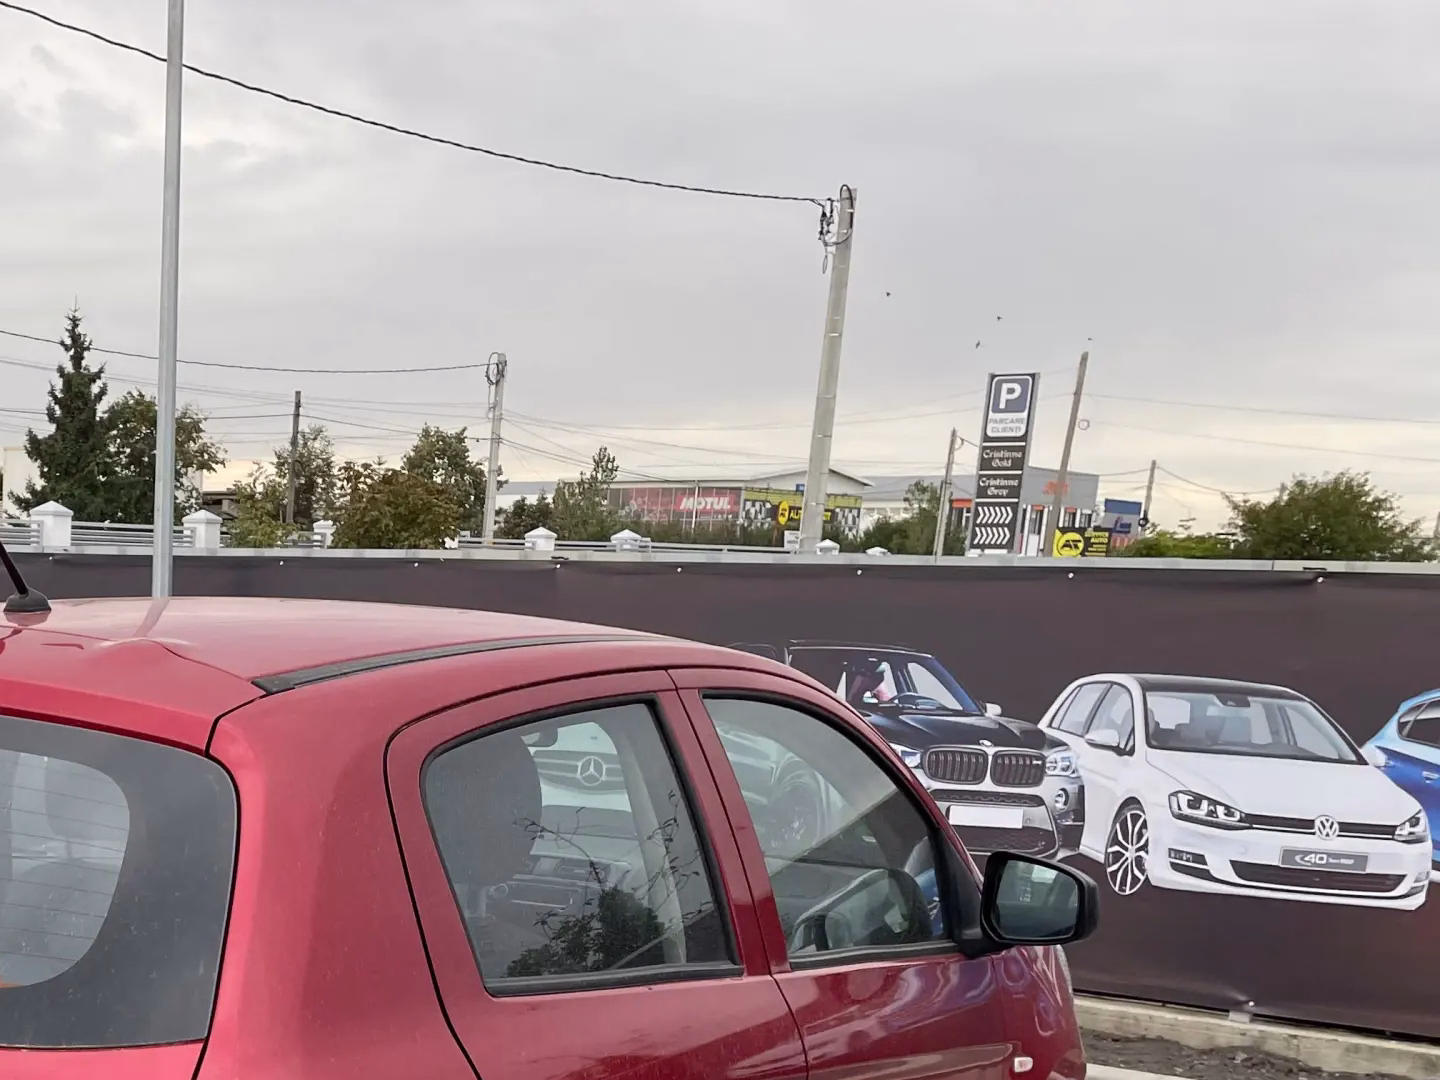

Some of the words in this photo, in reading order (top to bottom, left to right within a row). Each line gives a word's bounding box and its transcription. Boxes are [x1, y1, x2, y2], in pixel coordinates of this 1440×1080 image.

[999, 382, 1021, 409] P
[989, 417, 1025, 425] PARCARE
[680, 496, 731, 510] MOTUL
